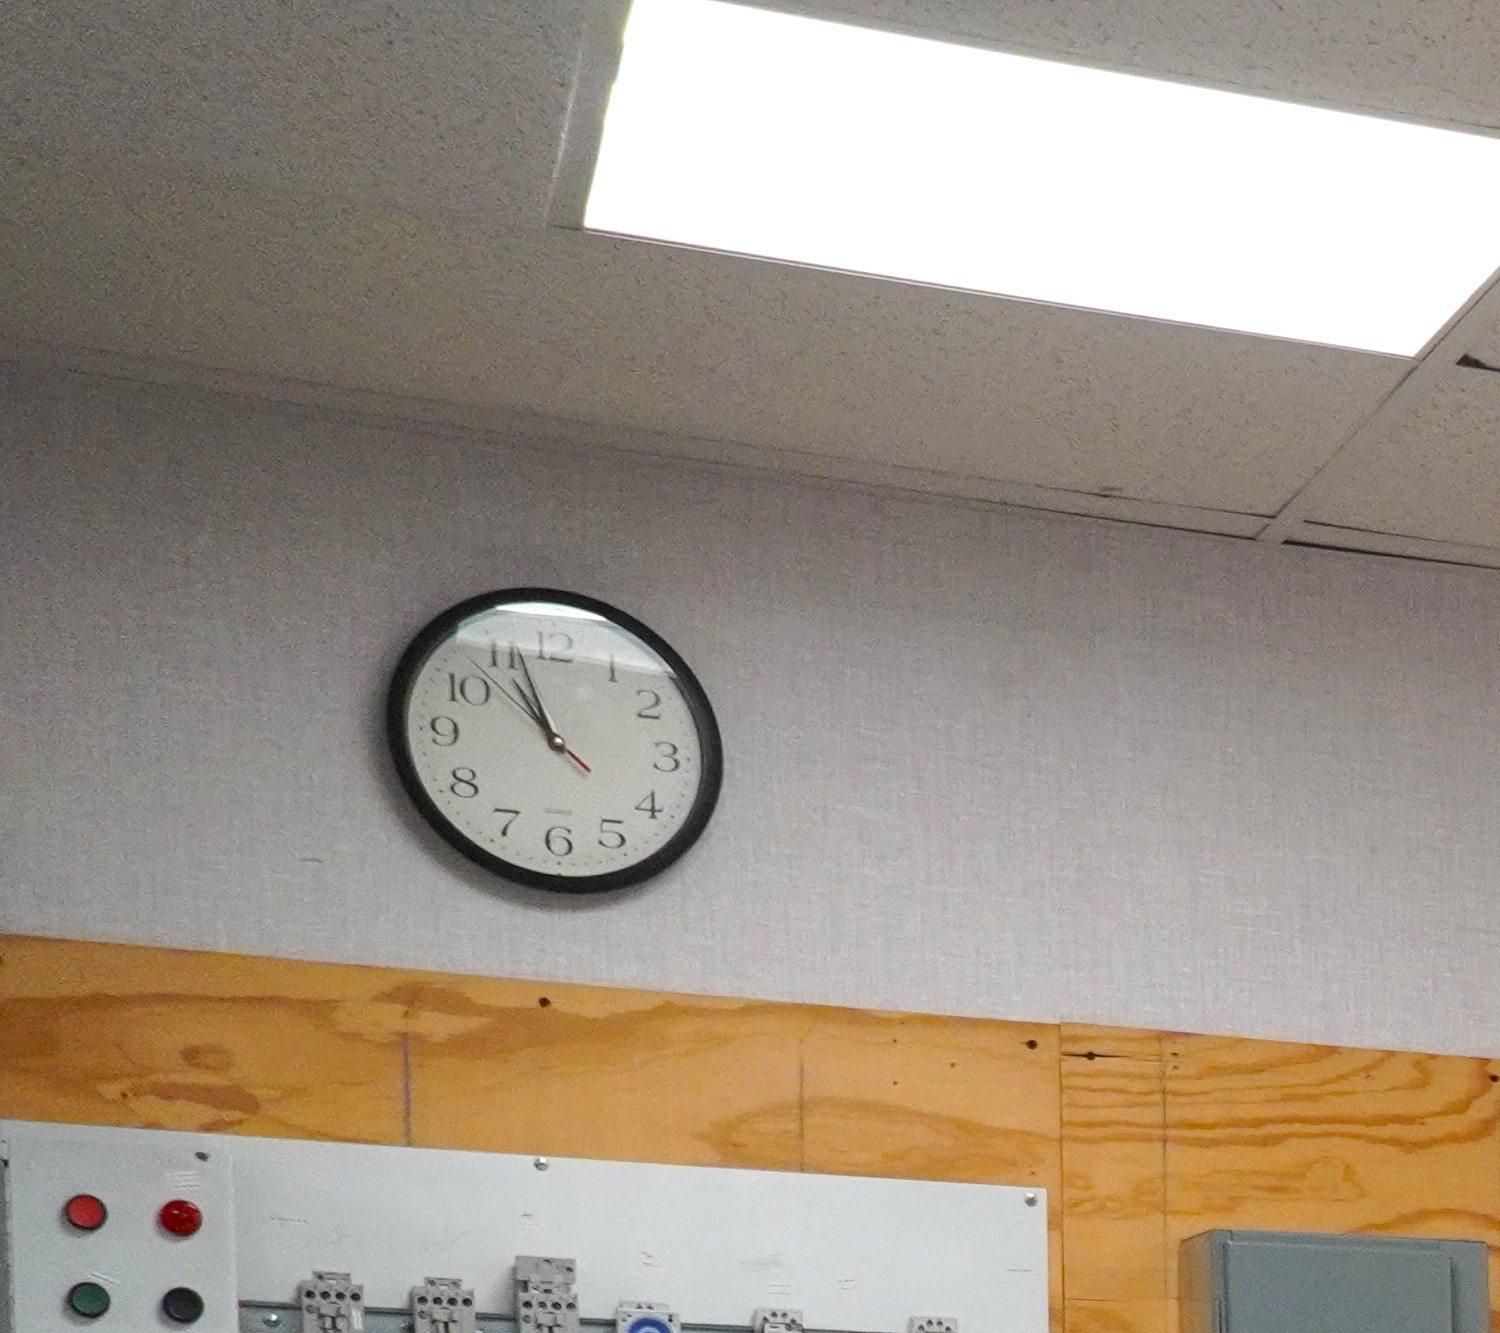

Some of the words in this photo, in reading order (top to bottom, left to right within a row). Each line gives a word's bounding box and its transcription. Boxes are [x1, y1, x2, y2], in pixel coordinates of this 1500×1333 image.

[488, 640, 518, 670] 11
[537, 631, 573, 663] 12
[605, 653, 619, 683] 1
[448, 672, 491, 706] 10
[636, 689, 662, 720] 2
[430, 715, 460, 747] 9
[653, 741, 681, 773] 3
[449, 766, 480, 799] 8
[634, 790, 664, 820] 4
[493, 807, 522, 838] 7
[598, 818, 627, 849] 5
[544, 825, 573, 857] 6
